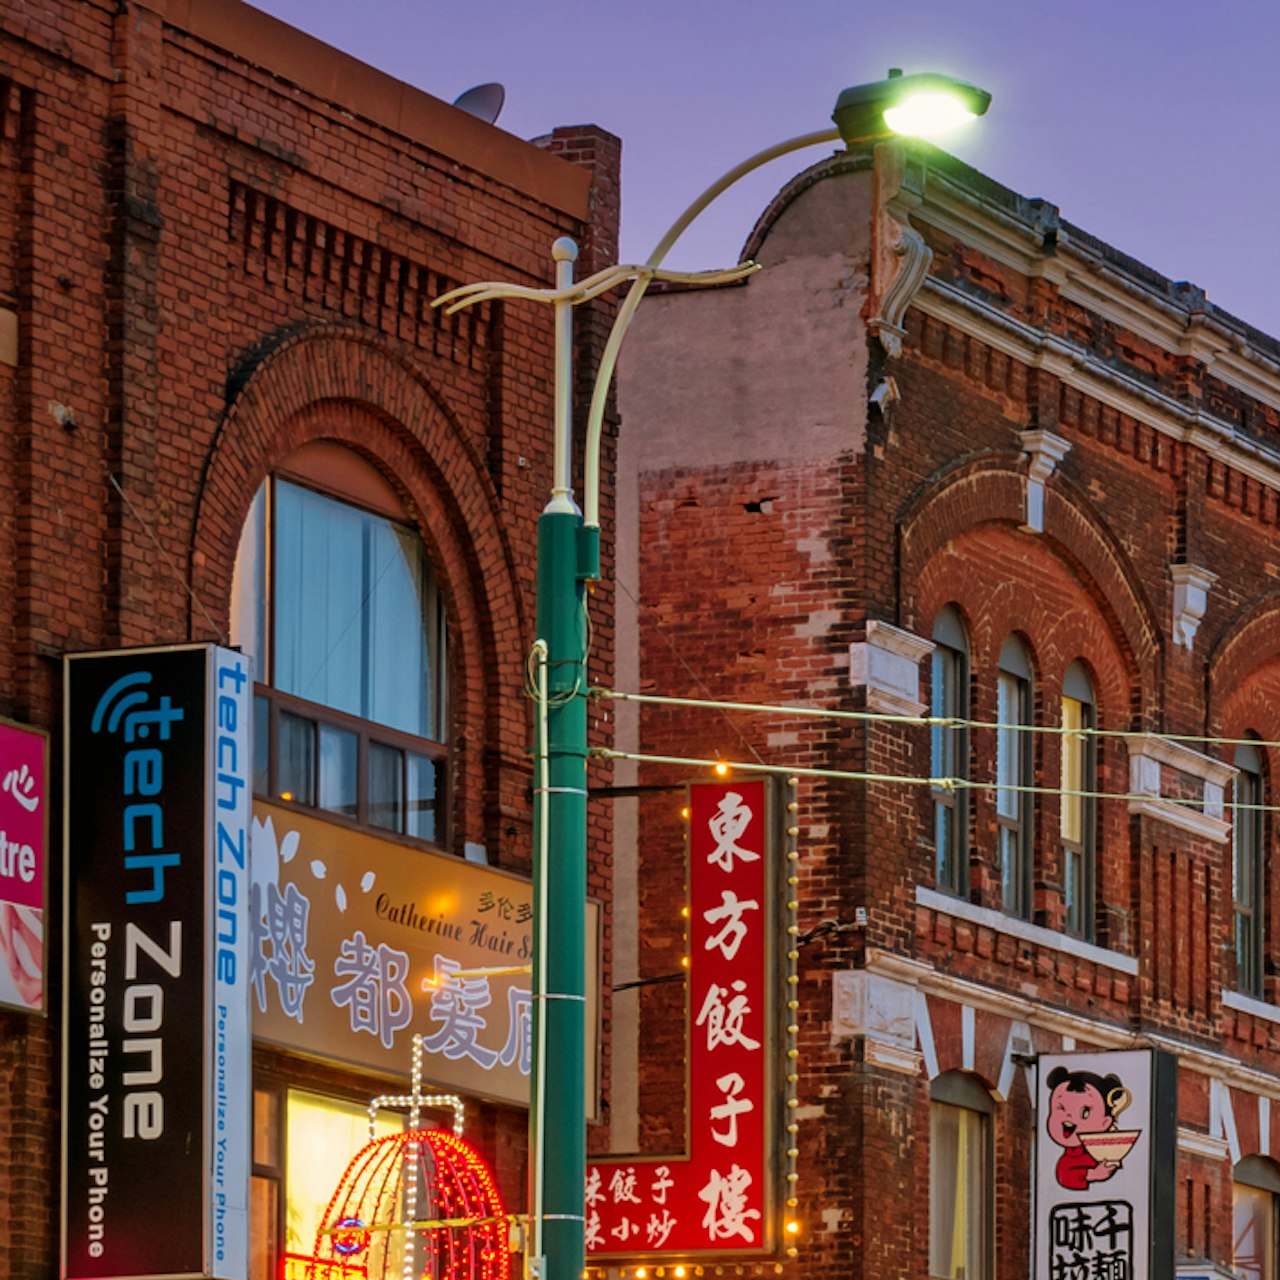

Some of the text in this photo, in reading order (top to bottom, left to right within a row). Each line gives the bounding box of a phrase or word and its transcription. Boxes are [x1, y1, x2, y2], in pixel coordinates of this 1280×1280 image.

[123, 693, 185, 1140] tech Zone
[217, 660, 248, 986] tech Zone
[375, 892, 463, 942] Catherine
[470, 919, 515, 955] Hair
[88, 922, 111, 1258] Personalize Your Phone
[215, 1004, 228, 1262] Personalize Your Phone
[696, 790, 762, 1244] 東方餃子樓
